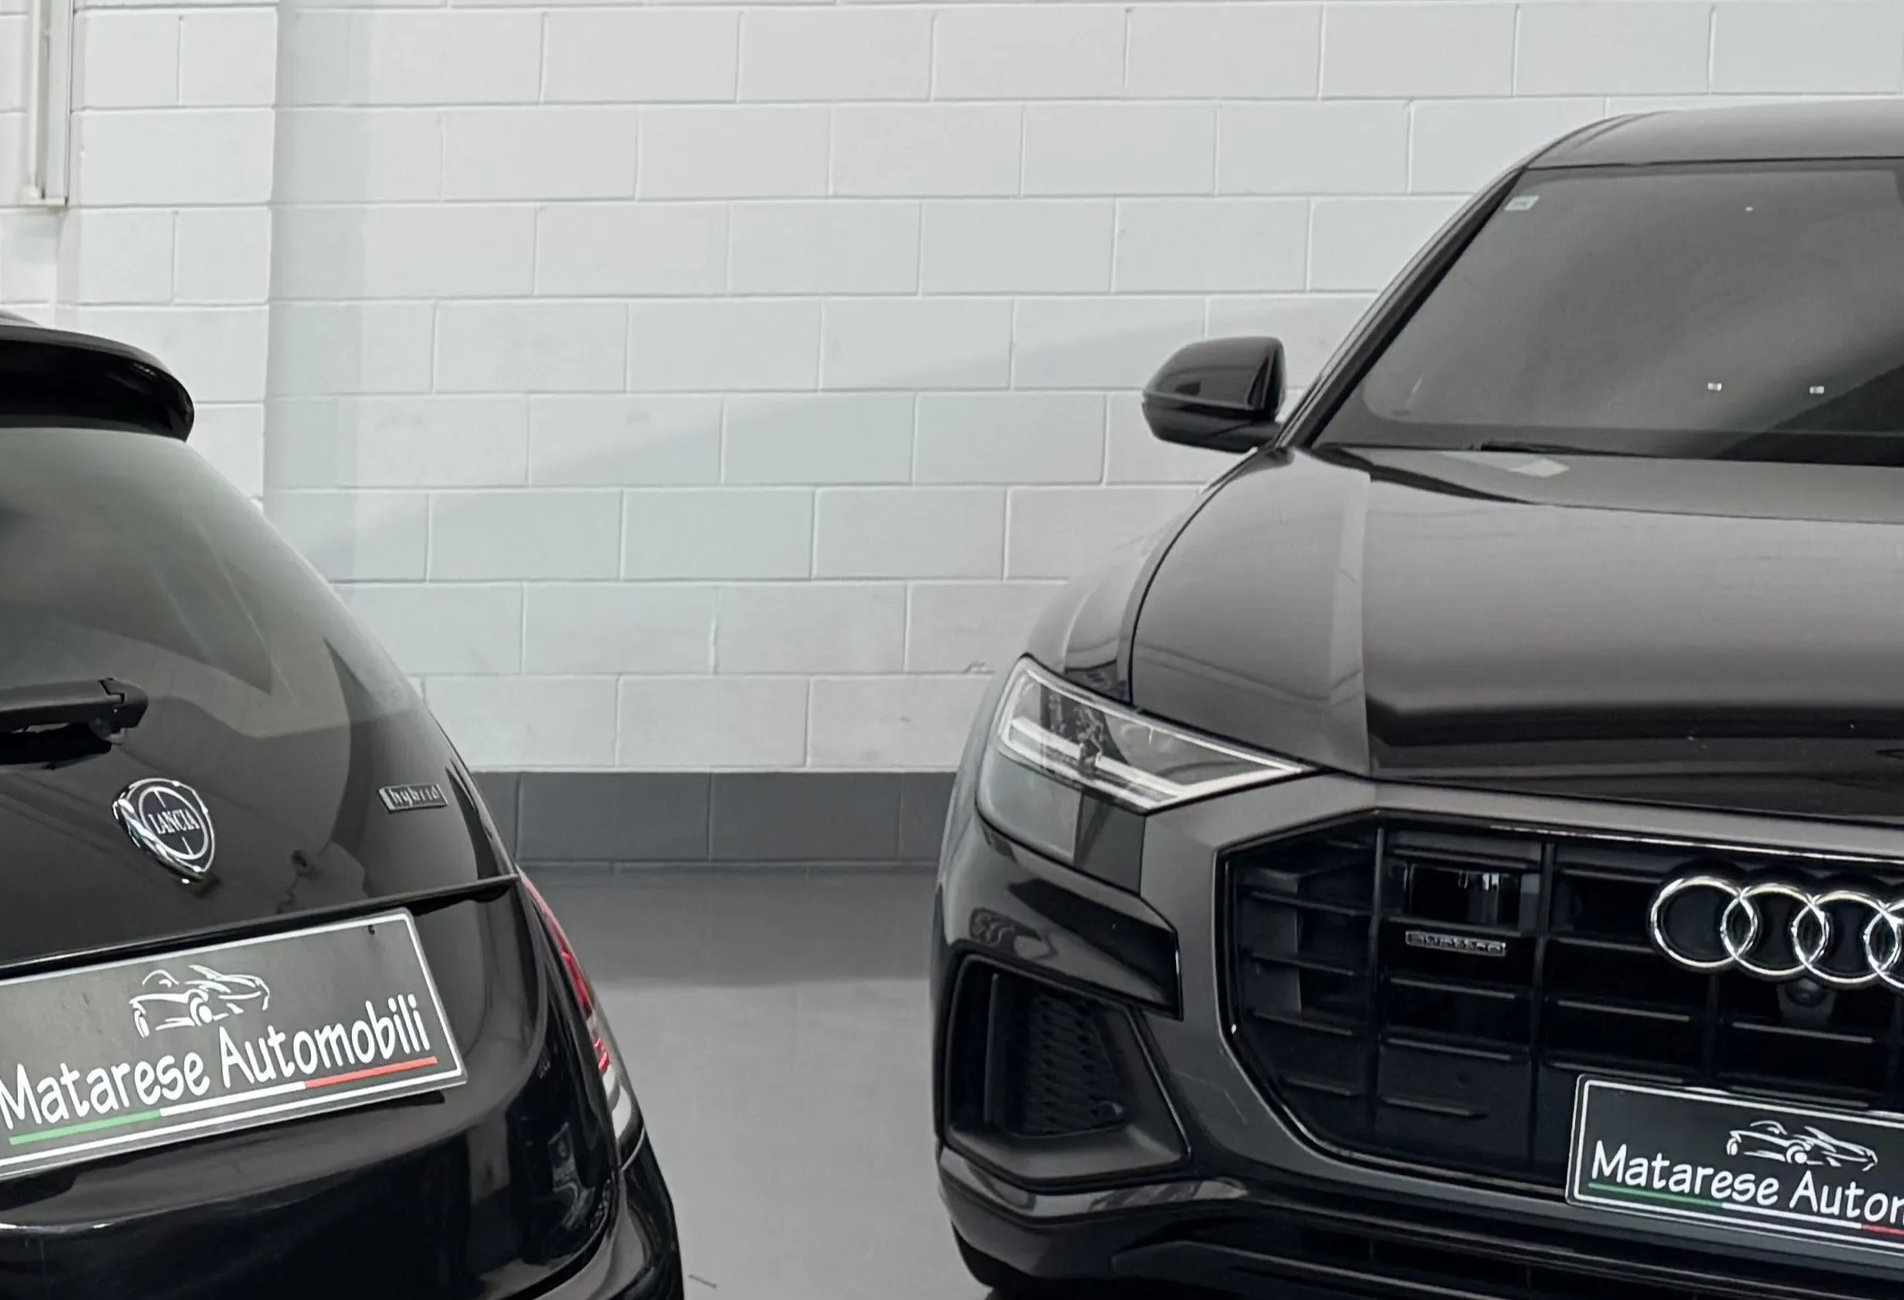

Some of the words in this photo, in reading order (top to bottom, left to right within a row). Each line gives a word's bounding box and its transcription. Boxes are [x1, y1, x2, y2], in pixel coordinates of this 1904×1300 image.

[388, 785, 441, 807] hybrid
[147, 807, 200, 835] LANCIA
[218, 993, 431, 1089] Automobili
[1591, 1139, 1780, 1206] Matarese
